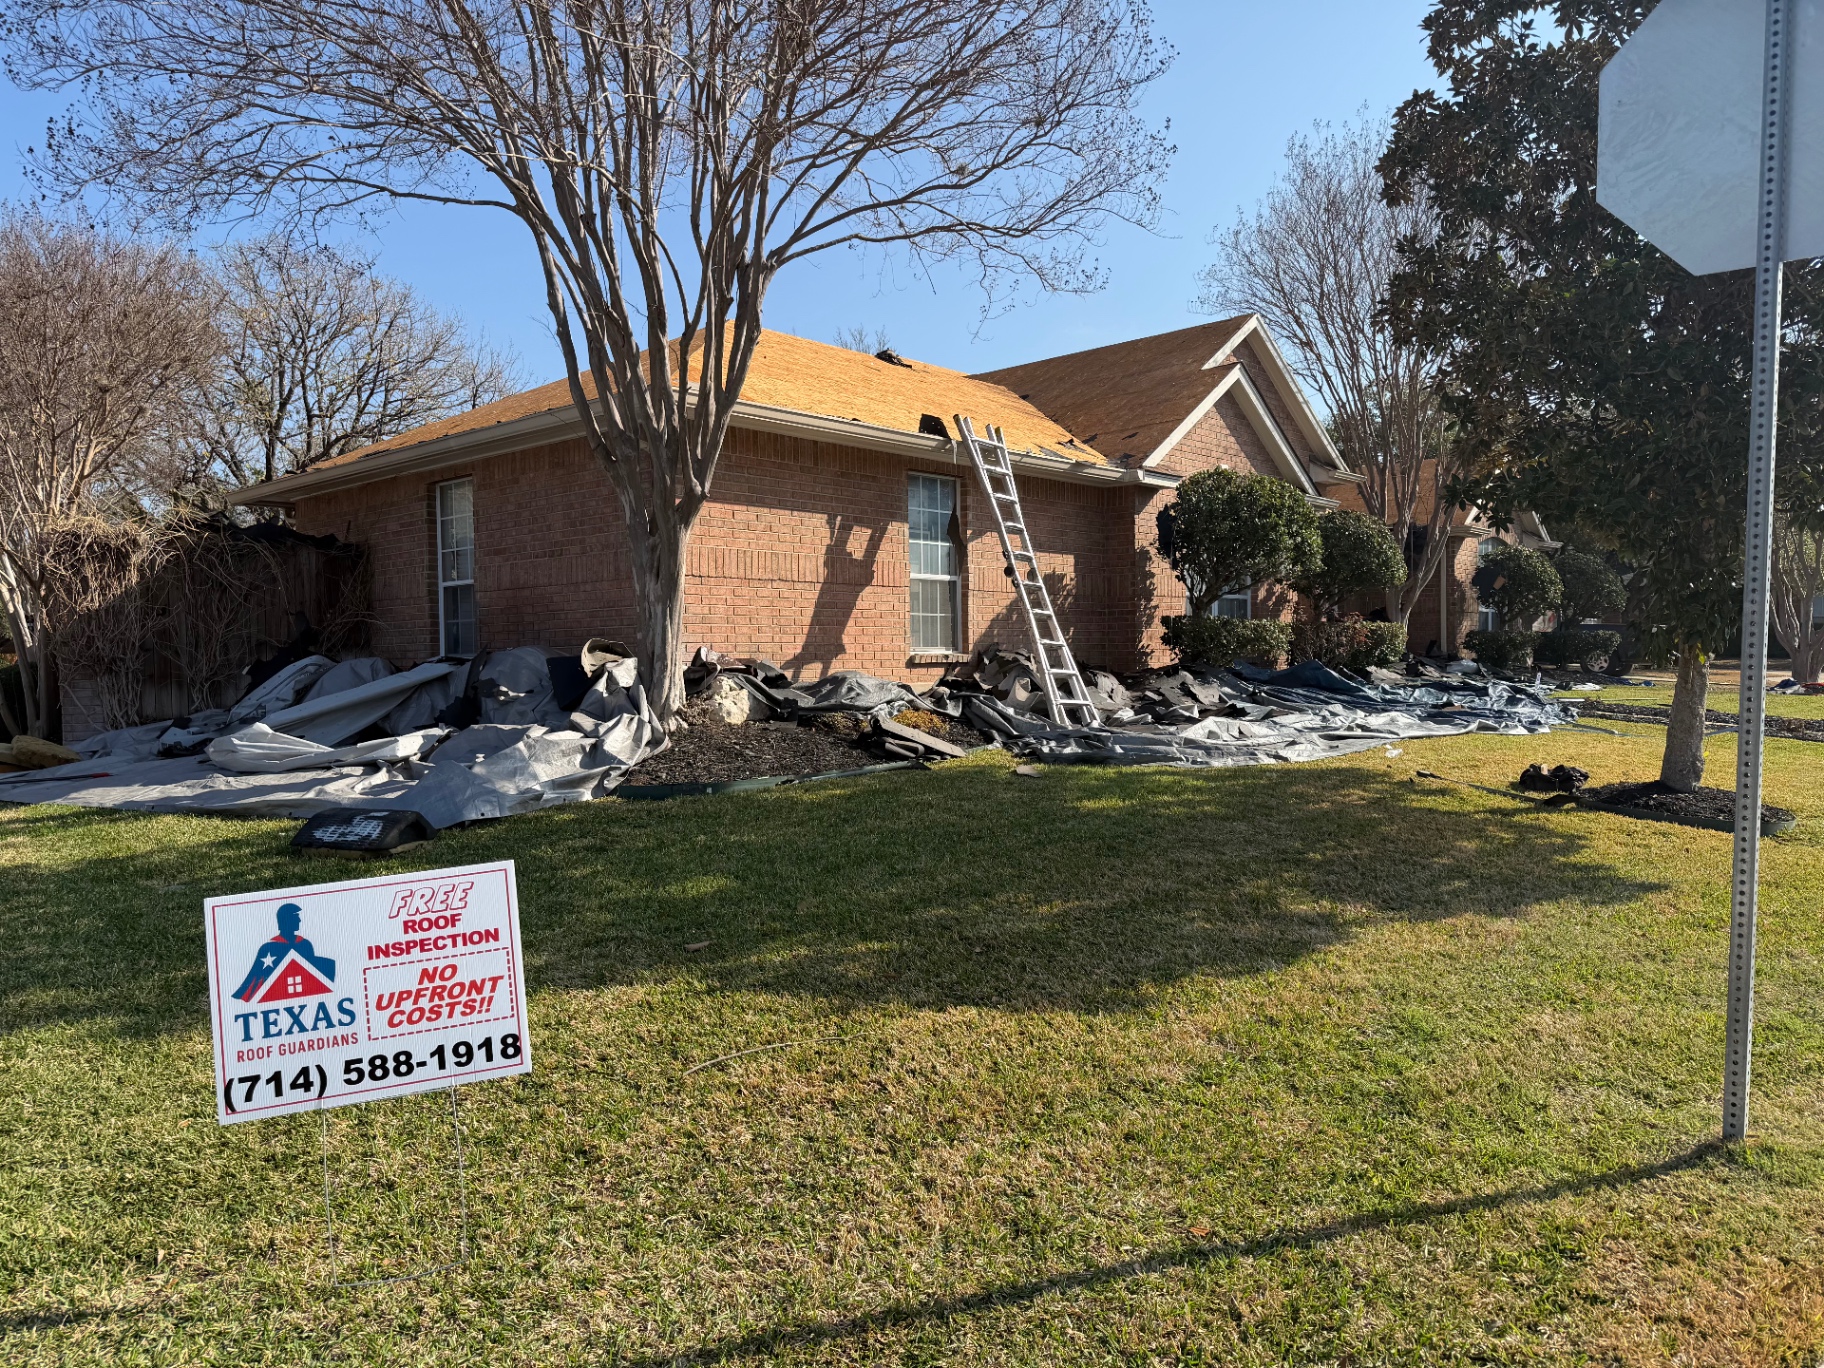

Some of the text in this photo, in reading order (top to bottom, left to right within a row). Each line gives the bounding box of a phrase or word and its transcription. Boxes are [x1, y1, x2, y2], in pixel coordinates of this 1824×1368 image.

[388, 881, 474, 919] FREE
[403, 913, 462, 935] ROOF
[367, 928, 500, 960] INSPECTION
[418, 964, 458, 986] NO
[375, 975, 504, 1011] UPFRONT
[234, 997, 356, 1042] TEXAS
[387, 995, 495, 1029] COSTS!!
[237, 1032, 359, 1063] ROOF GUARDIANS
[224, 1033, 521, 1112] (714) 588-1918
